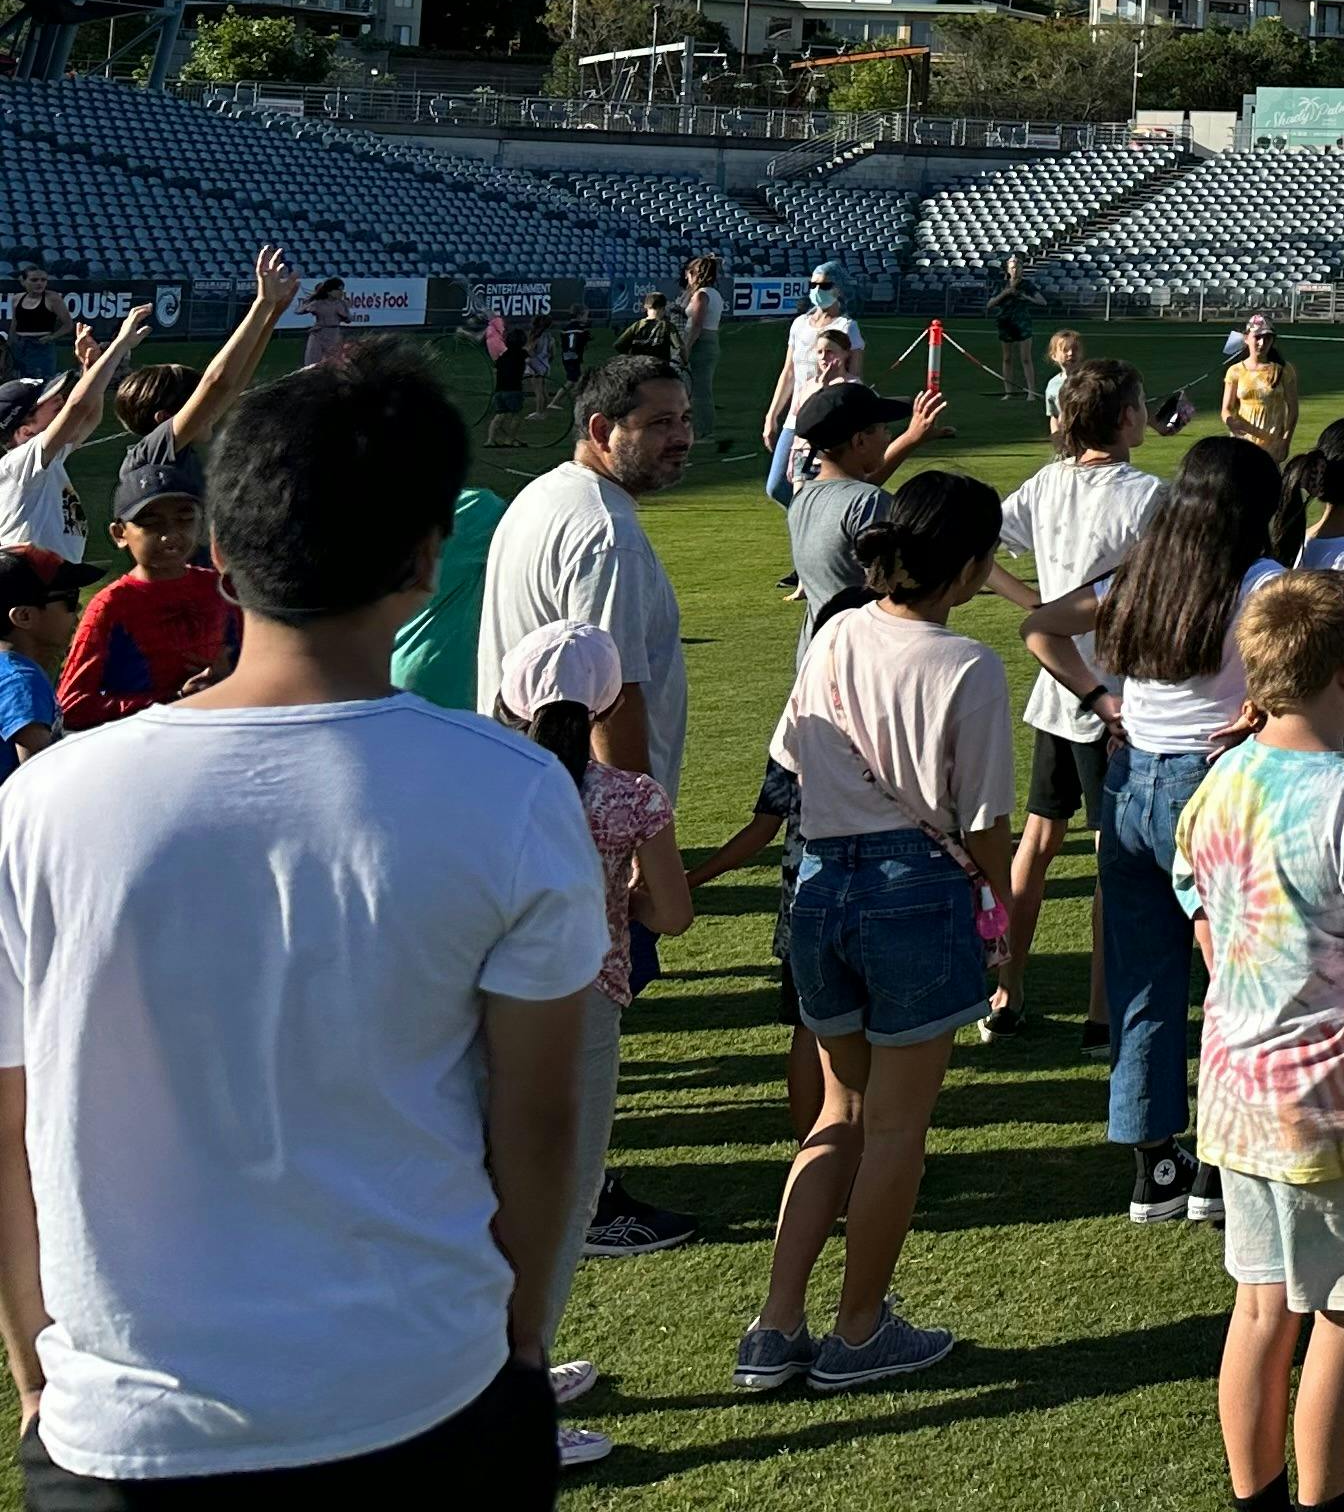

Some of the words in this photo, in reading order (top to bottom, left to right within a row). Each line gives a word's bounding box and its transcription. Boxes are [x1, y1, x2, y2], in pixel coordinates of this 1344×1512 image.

[486, 284, 552, 295] ENTERTAINMENT
[734, 283, 782, 310] BTS
[383, 292, 409, 308] Foot
[492, 294, 552, 316] EVENTS
